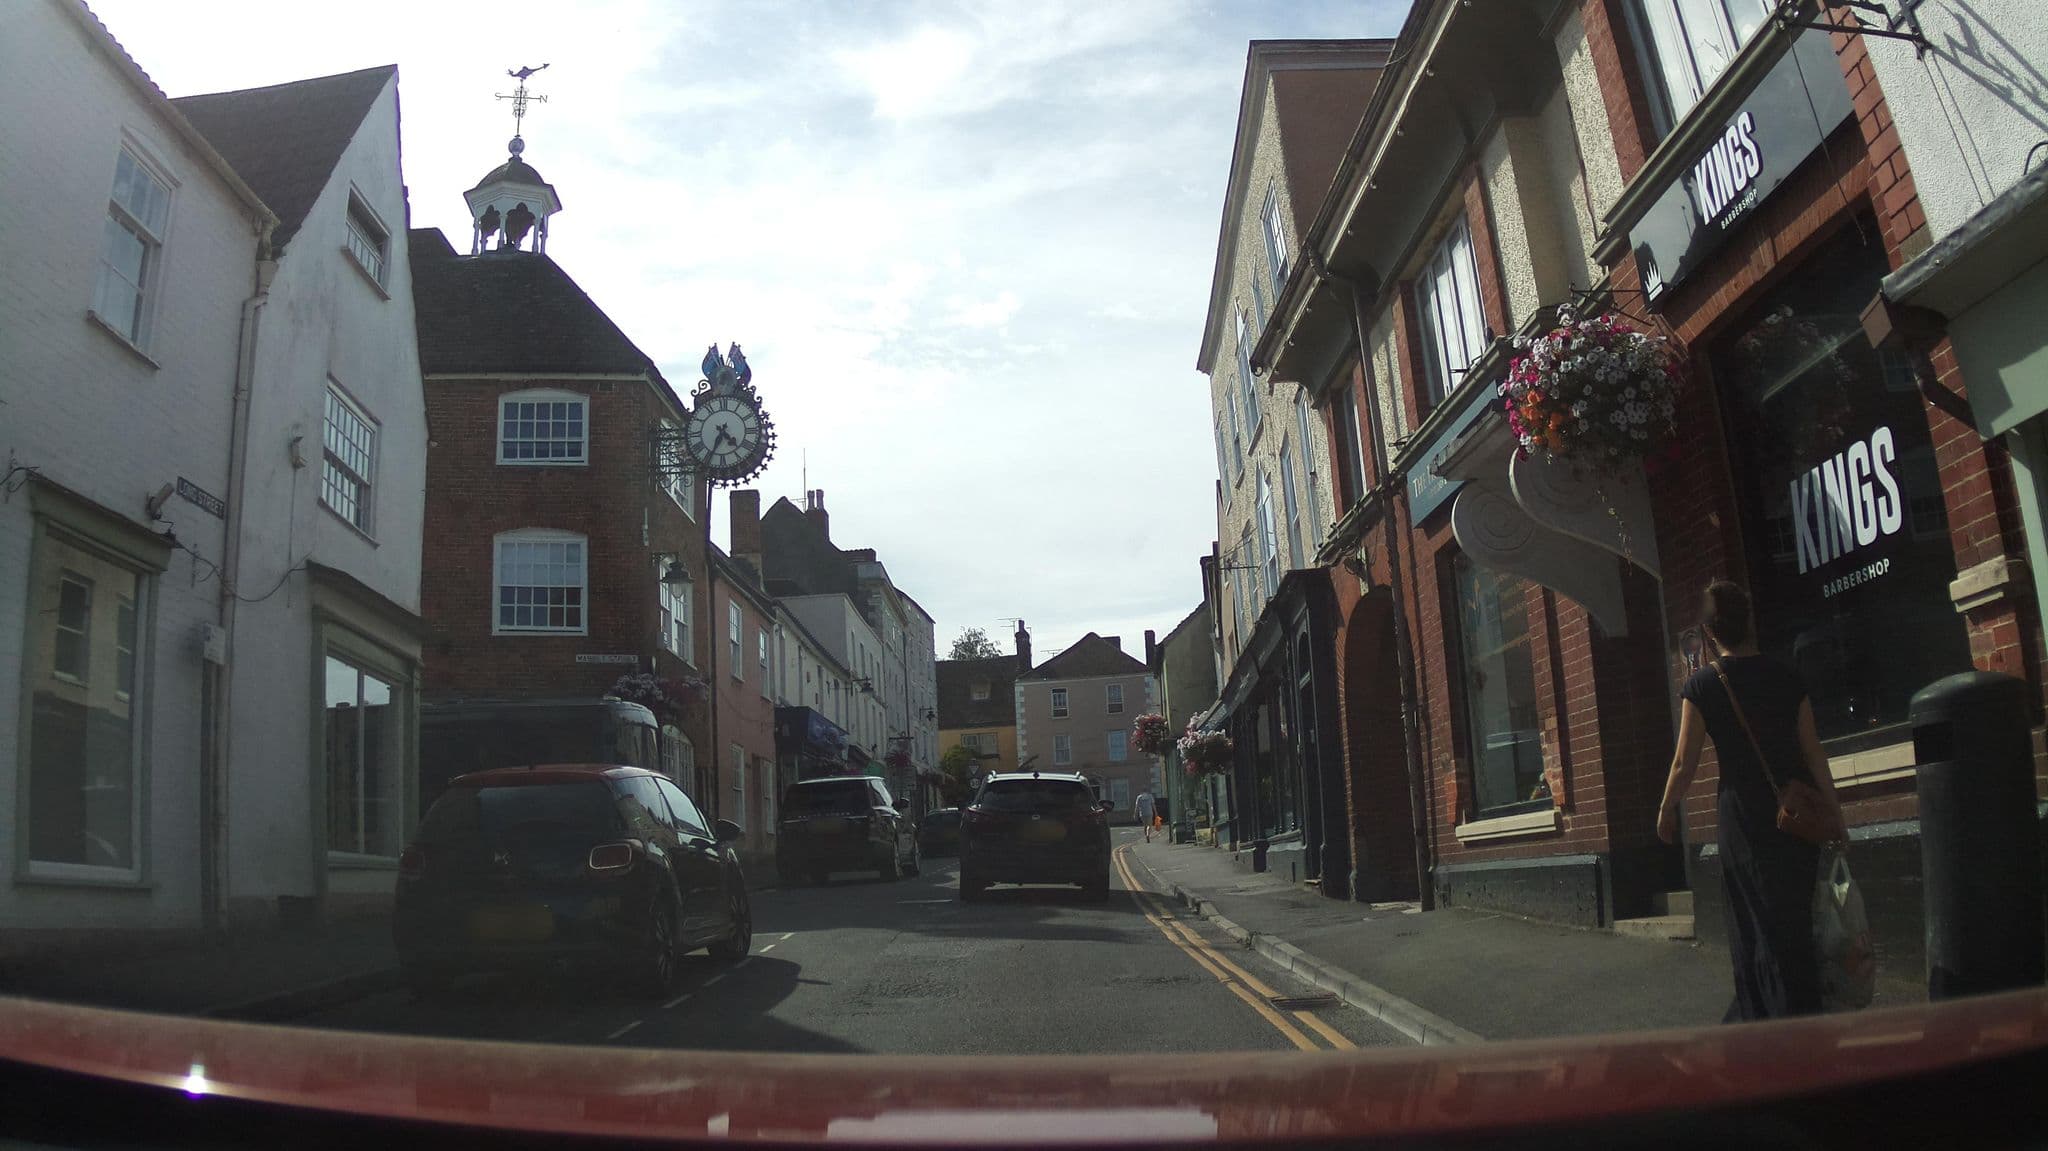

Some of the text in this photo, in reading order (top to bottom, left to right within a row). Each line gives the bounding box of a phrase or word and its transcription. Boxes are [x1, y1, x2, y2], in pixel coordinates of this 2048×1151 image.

[540, 95, 548, 103] N
[1694, 111, 1762, 226] KINGS
[1720, 188, 1758, 230] BARBERSHOP
[1790, 425, 1903, 575] KINGS
[1823, 557, 1891, 599] BARBERSHOP
[577, 655, 639, 663] MART STRT
